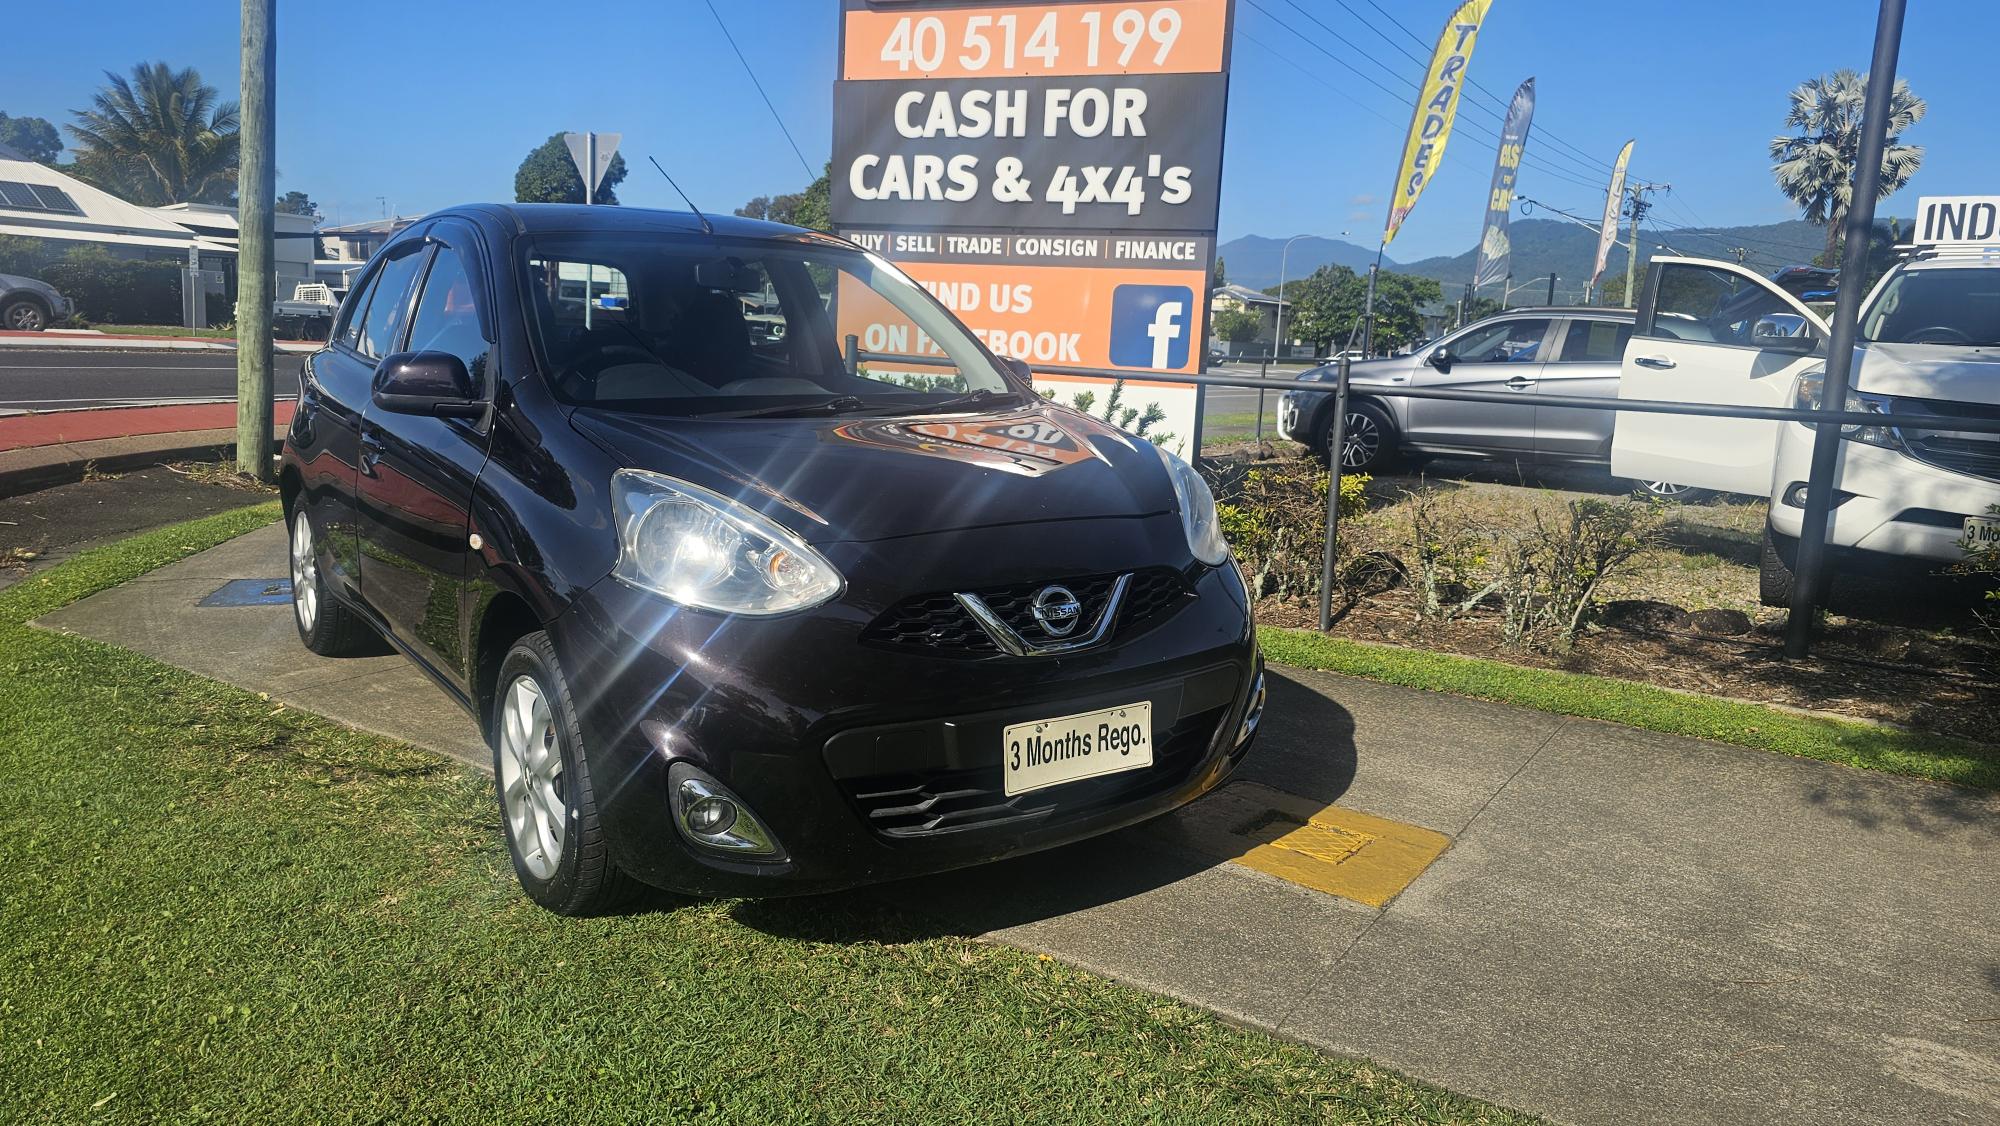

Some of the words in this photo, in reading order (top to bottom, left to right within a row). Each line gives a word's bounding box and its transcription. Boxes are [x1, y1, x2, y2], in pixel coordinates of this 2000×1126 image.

[880, 17, 946, 72] 40
[958, 11, 1060, 70] 514
[1079, 7, 1182, 67] 199
[894, 89, 1028, 138] CASH
[1043, 87, 1148, 138] FOR
[1407, 24, 1477, 197] TRADES
[849, 154, 980, 202] CARS
[991, 156, 1033, 203] &
[1923, 202, 2000, 241] IND
[850, 234, 885, 251] BUY
[895, 235, 935, 253] SELL
[946, 236, 1002, 255] TRADE
[1015, 238, 1098, 257] CONSIGN
[1115, 240, 1196, 261] FINANCE
[989, 284, 1033, 314] US
[865, 323, 909, 353] ON
[916, 326, 1081, 363] FBOOK
[1967, 525, 1975, 540] 3
[1041, 605, 1079, 619] NISSAN
[1011, 740, 1021, 771] 3
[1026, 730, 1092, 768] Months
[1098, 723, 1146, 756] Rego.
